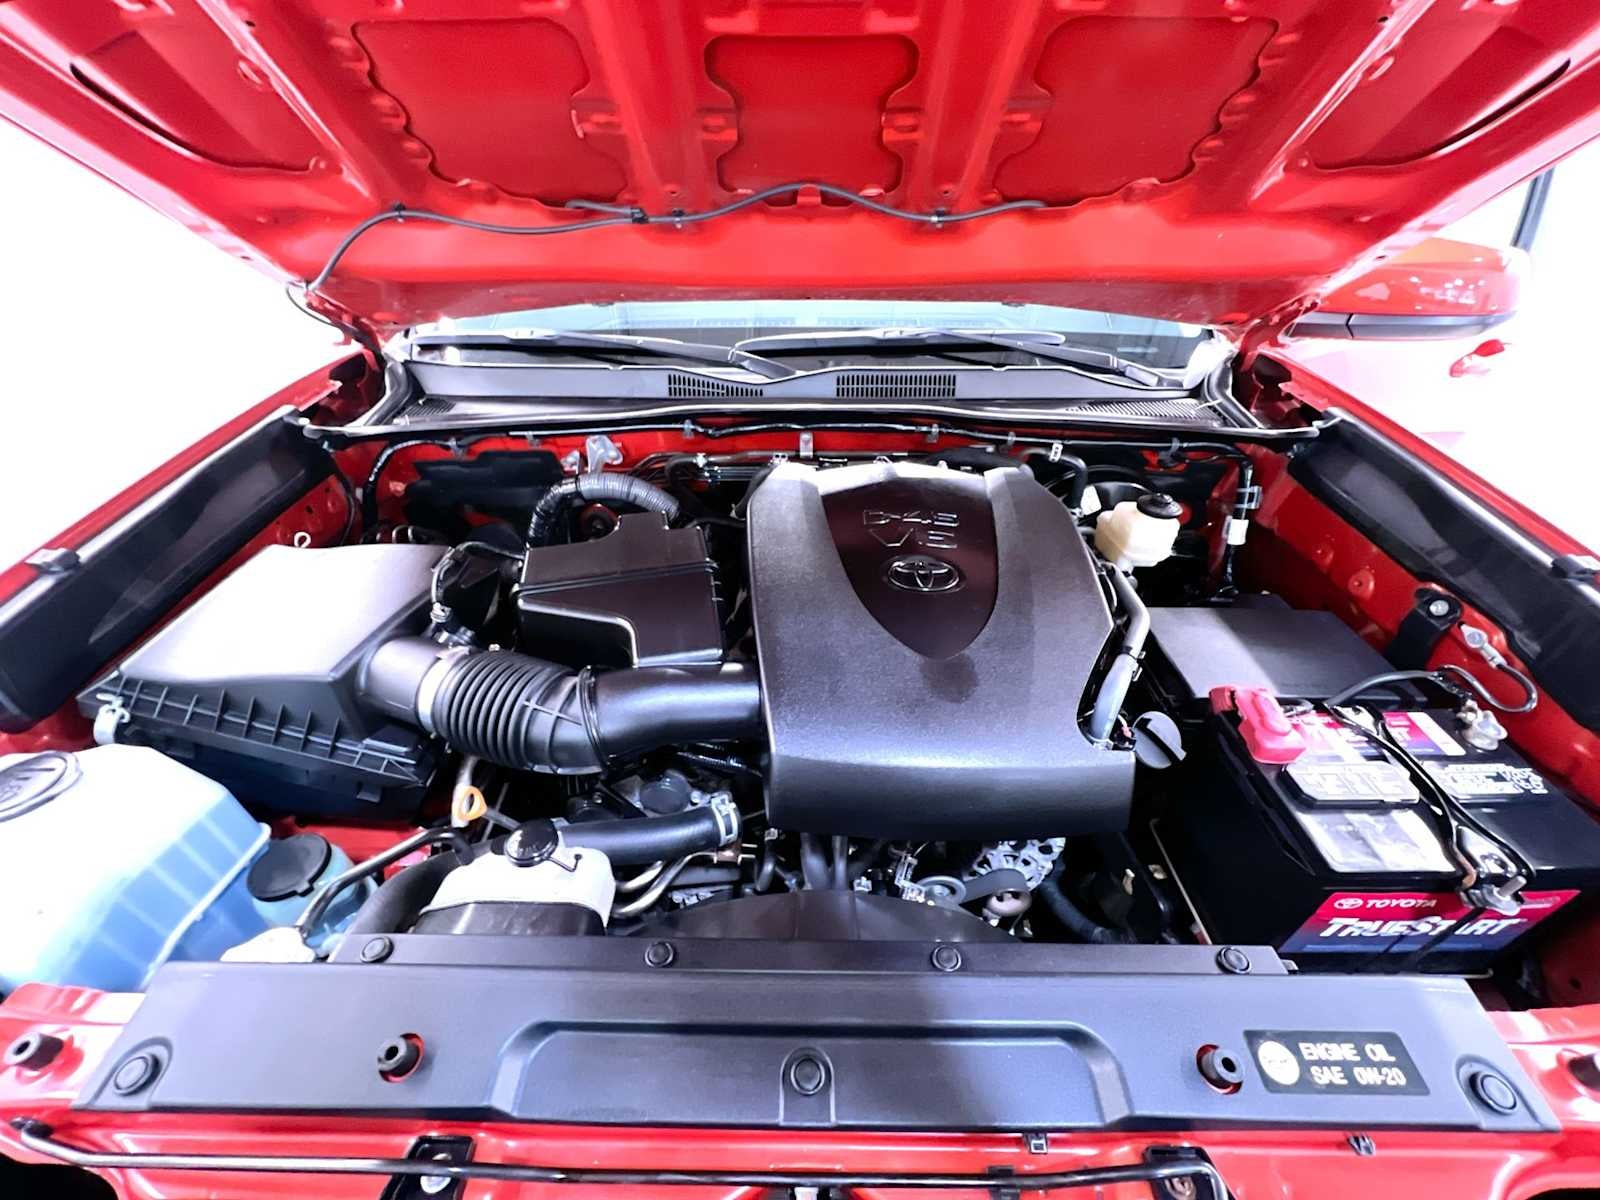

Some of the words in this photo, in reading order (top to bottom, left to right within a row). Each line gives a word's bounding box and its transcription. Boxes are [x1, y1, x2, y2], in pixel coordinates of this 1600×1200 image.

[1366, 898, 1438, 909] TOYOTA
[1298, 1042, 1361, 1061] ENGINE
[1364, 1043, 1396, 1062] OIL
[1310, 1066, 1349, 1085] SAE
[1353, 1066, 1407, 1086] 0W-20
